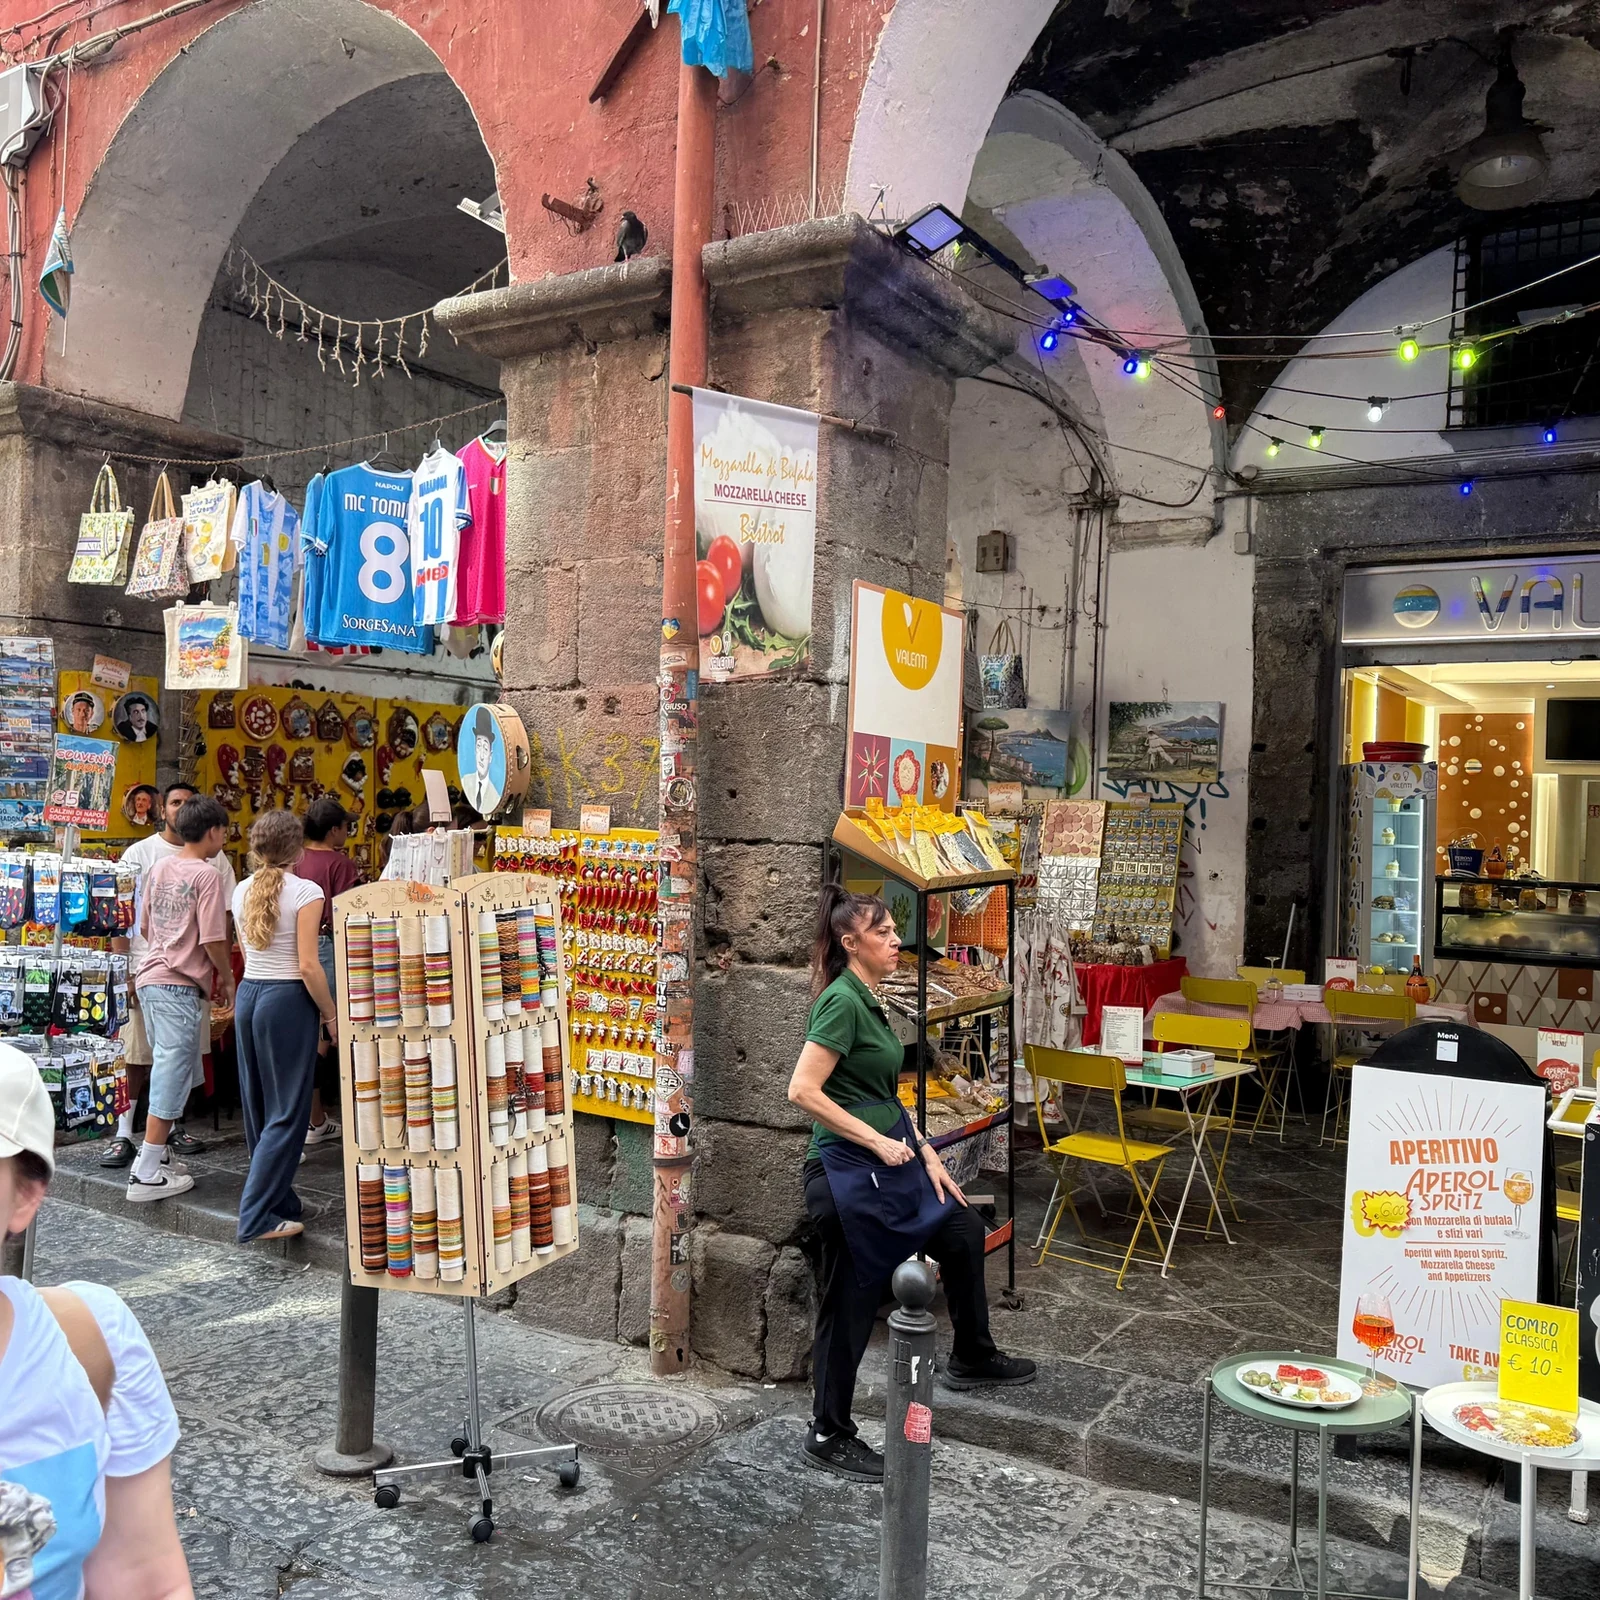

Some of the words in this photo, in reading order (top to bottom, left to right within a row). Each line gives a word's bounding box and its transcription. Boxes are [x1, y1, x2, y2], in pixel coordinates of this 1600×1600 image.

[701, 443, 763, 481] Mozzarella
[766, 456, 777, 477] di
[780, 456, 814, 489] Bufala
[375, 481, 404, 492] NAPOLI
[714, 483, 774, 503] MOZZARELLA
[774, 490, 807, 506] CHEESE
[344, 493, 366, 512] MC
[370, 496, 409, 519] TOMI
[419, 497, 443, 561] 10
[740, 513, 785, 545] Bistrot
[358, 521, 409, 604] 8
[709, 657, 735, 669] VALENTI
[896, 648, 928, 669] VALENTI
[56, 749, 115, 766] SOUVENIR
[64, 762, 106, 775] AURORA
[48, 813, 71, 821] SOCKS
[71, 815, 81, 823] OF
[82, 816, 106, 825] NAPLES
[49, 807, 75, 815] CALZINI
[83, 811, 107, 819] NAPOLI
[1437, 1032, 1459, 1040] Menù
[78, 1109, 89, 1117] 10
[1390, 1137, 1499, 1165] APERITIVO
[1405, 1168, 1499, 1197] APEROL
[1424, 1215, 1471, 1226] Mozzarella
[1473, 1215, 1481, 1226] di
[1484, 1215, 1512, 1226] bufala
[1437, 1229, 1443, 1238] e
[1445, 1228, 1463, 1238] sfizi
[1465, 1228, 1483, 1238] vari
[1404, 1248, 1432, 1258] Aperitif
[1434, 1248, 1451, 1258] with
[1453, 1249, 1480, 1259] Aperol
[1482, 1249, 1508, 1260] Spritz,
[1420, 1260, 1463, 1270] Mozzarella
[1465, 1261, 1495, 1270] Cheese
[1428, 1272, 1442, 1281] and
[1444, 1272, 1491, 1283] Appetizzers
[1506, 1314, 1559, 1337] COMBO
[1505, 1331, 1558, 1353] CLASSICA
[1449, 1344, 1479, 1364] TAKE
[1507, 1353, 1522, 1371] €
[1530, 1356, 1551, 1376] 10
